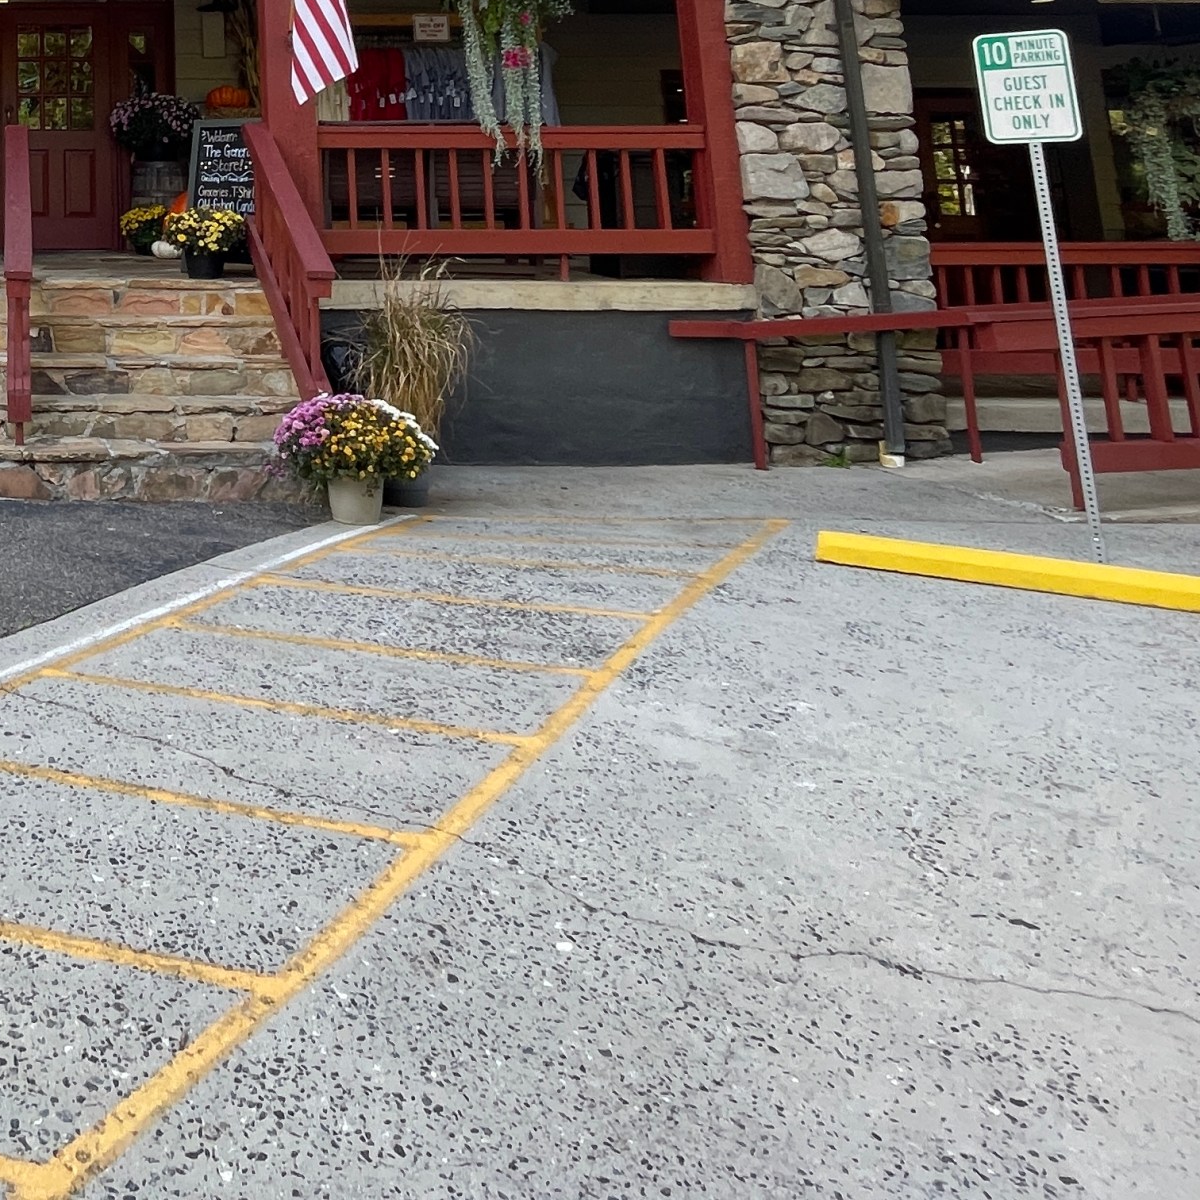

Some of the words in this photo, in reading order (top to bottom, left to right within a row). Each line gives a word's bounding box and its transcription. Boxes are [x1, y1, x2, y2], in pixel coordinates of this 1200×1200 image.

[1015, 38, 1056, 51] MINUTE
[981, 41, 1007, 66] 10
[1013, 49, 1061, 64] PARKING
[1003, 74, 1048, 92] GUEST
[994, 95, 1043, 111] CHECK
[1048, 93, 1066, 109] IN
[1012, 113, 1050, 130] ONLY
[203, 144, 222, 158] The
[211, 159, 244, 173] Store!
